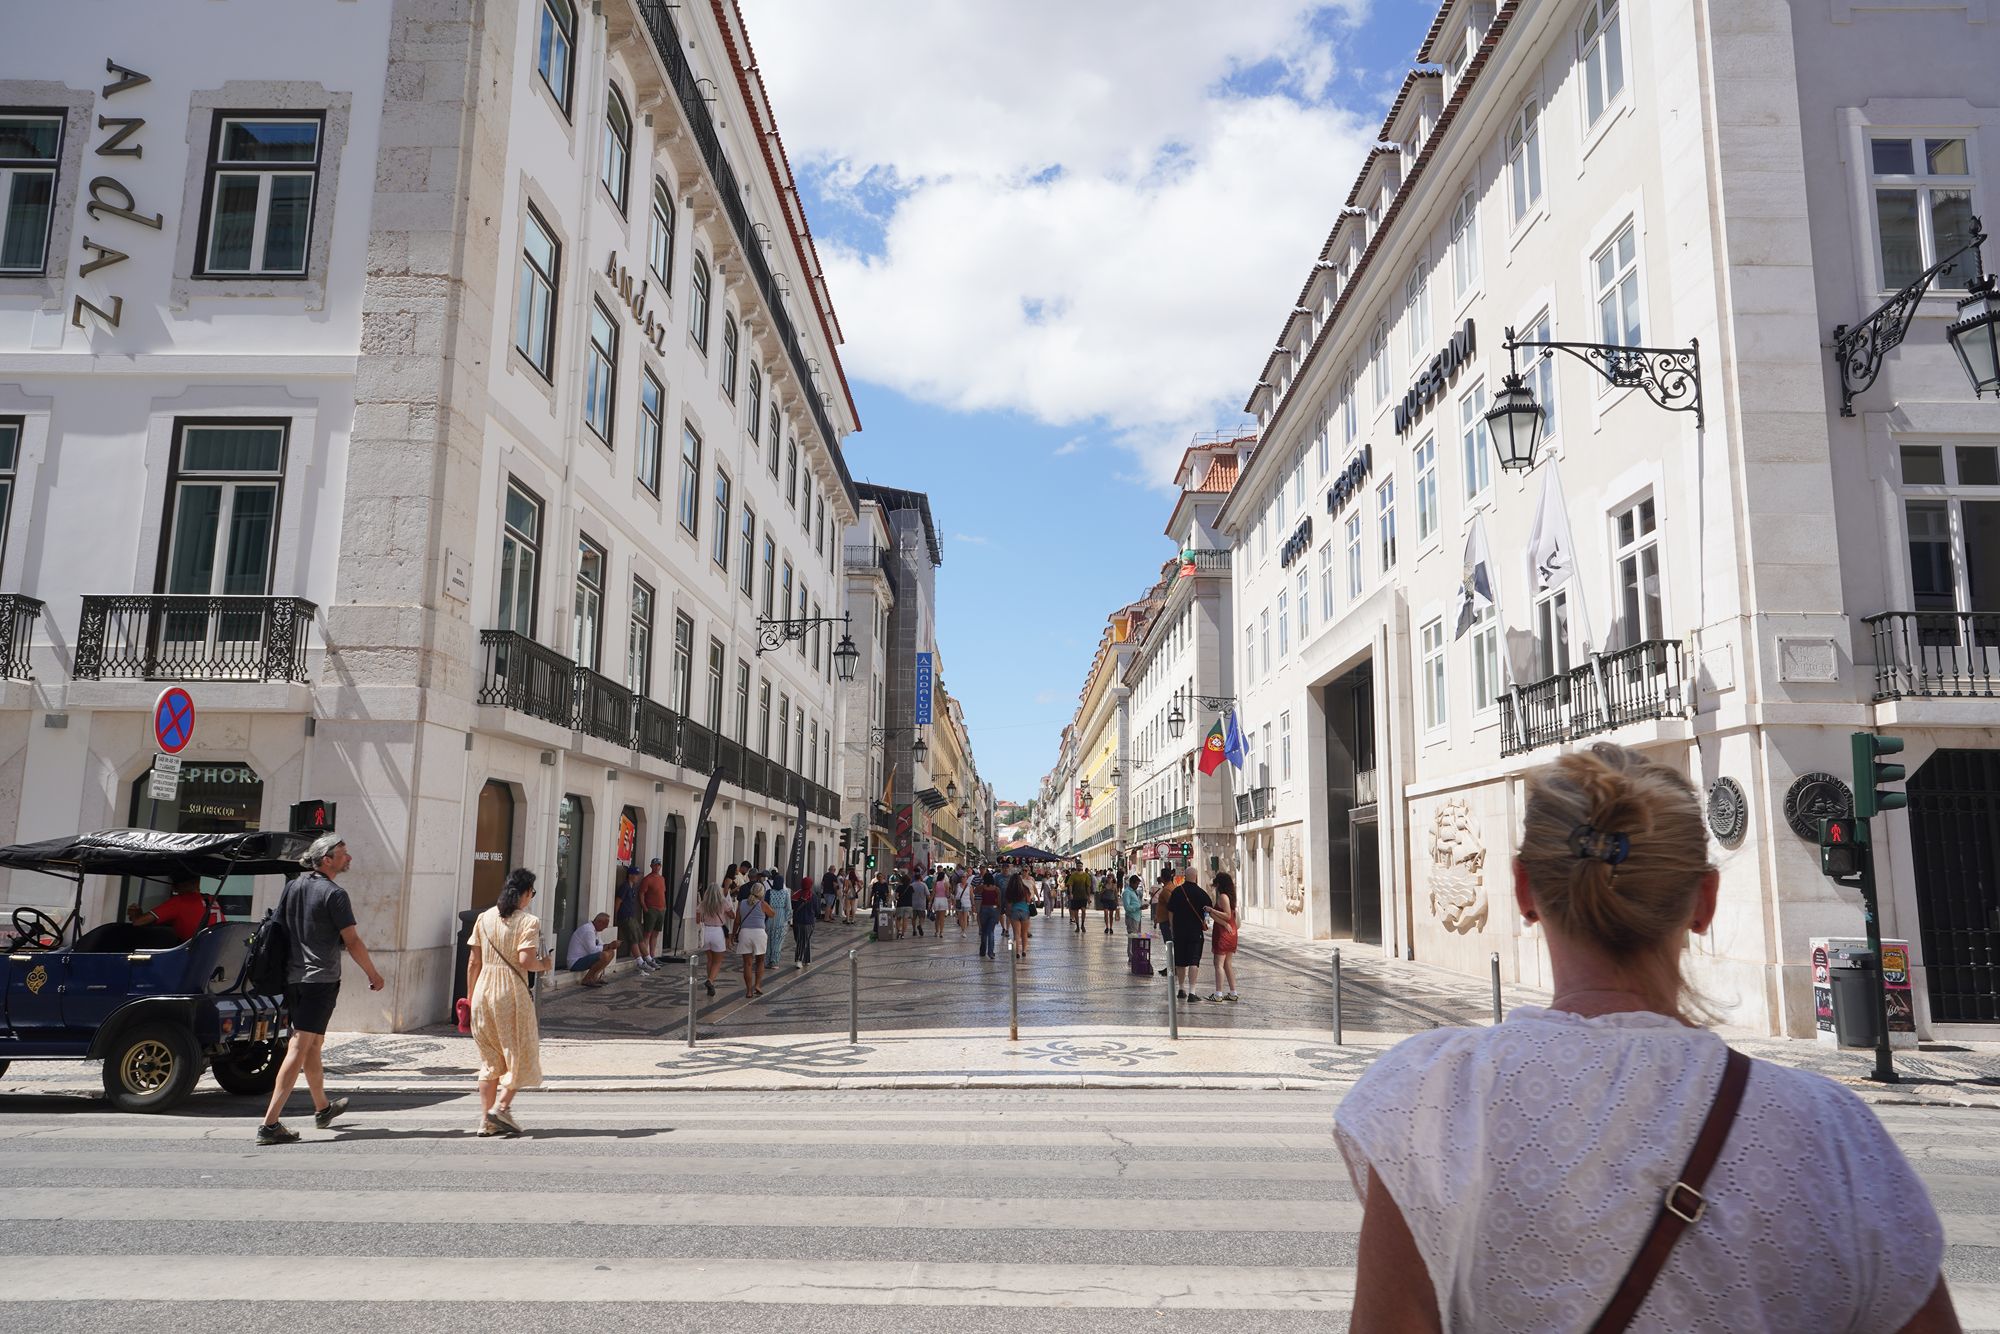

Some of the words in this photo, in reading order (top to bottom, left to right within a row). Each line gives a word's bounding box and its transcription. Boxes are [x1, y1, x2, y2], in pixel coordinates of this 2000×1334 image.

[1281, 516, 1313, 569] MUSEU
[1327, 444, 1373, 515] DESIGN
[1395, 318, 1477, 436] MUSEUM
[178, 768, 261, 783] EPHOR
